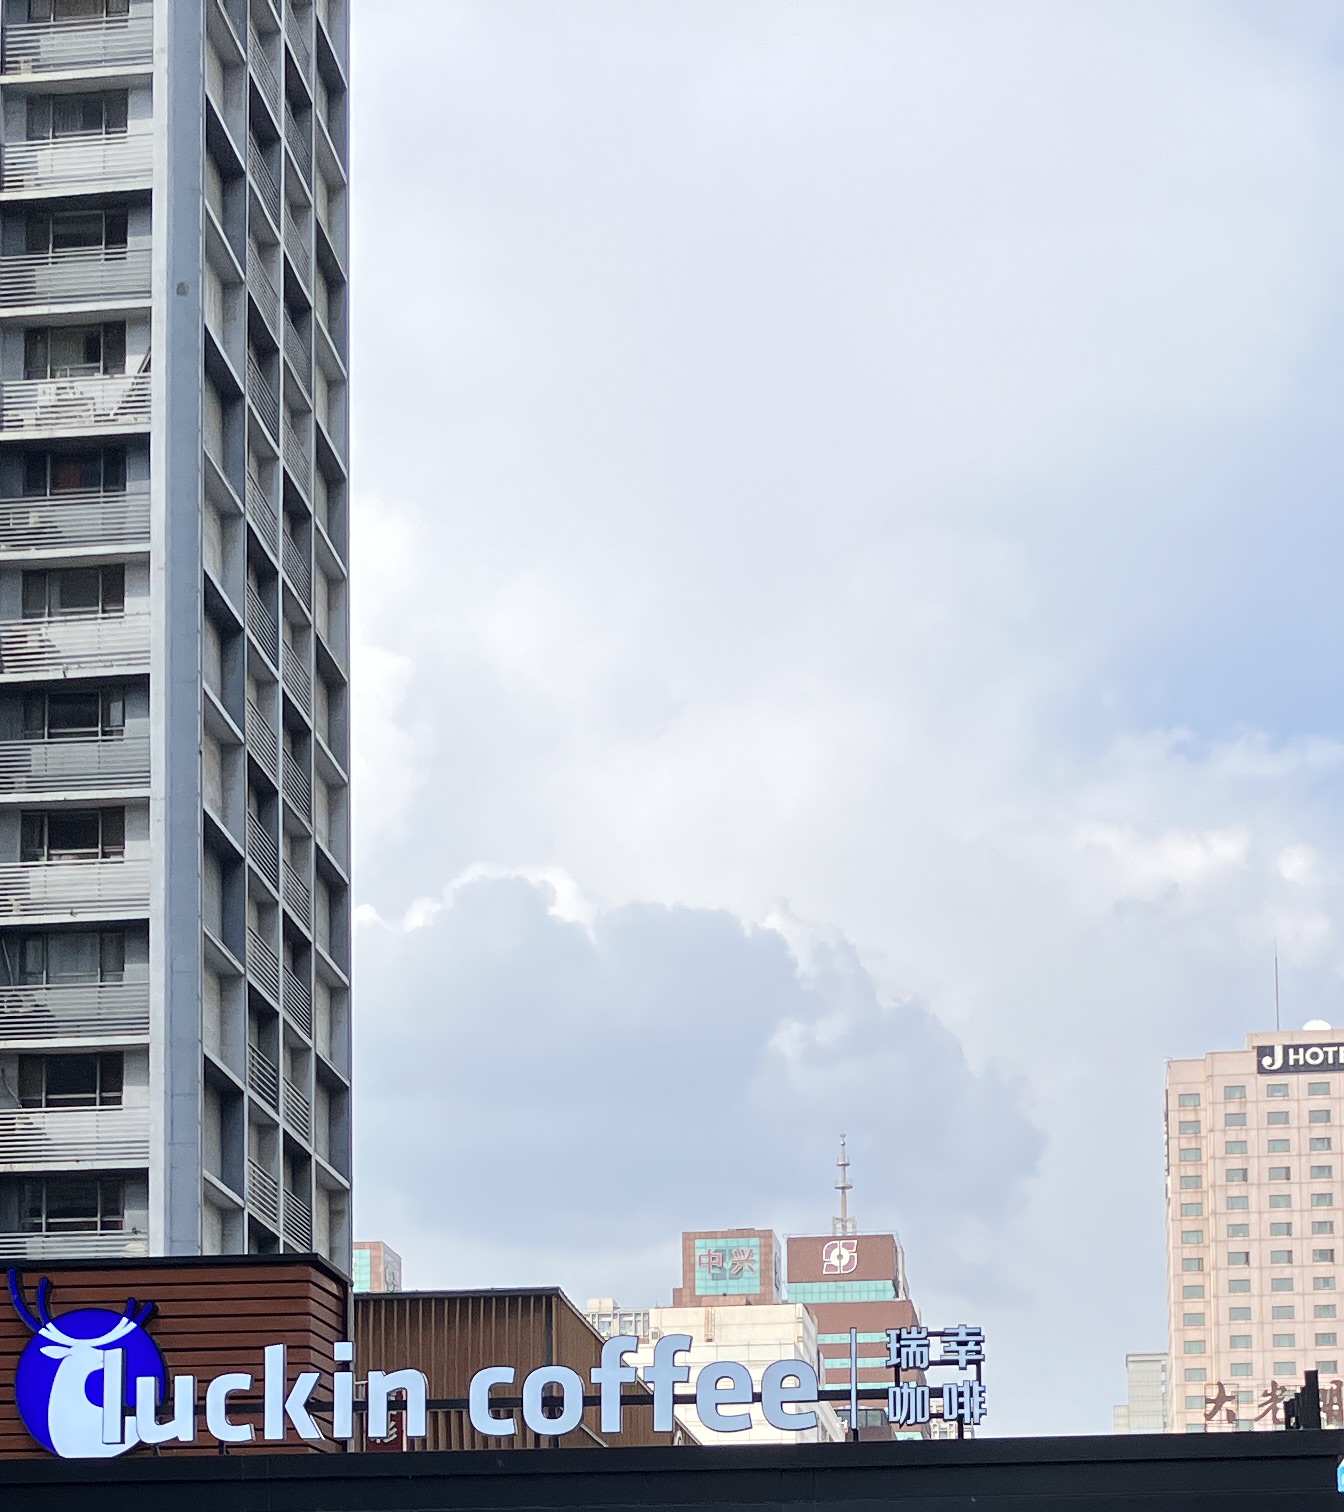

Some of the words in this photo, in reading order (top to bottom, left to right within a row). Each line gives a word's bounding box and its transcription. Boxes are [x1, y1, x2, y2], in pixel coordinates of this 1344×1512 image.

[698, 1247, 757, 1276] 中兴
[885, 1323, 986, 1371] 瑞幸
[103, 1340, 427, 1446] luckin
[468, 1333, 819, 1437] coffee
[886, 1379, 988, 1430] 咖啡
